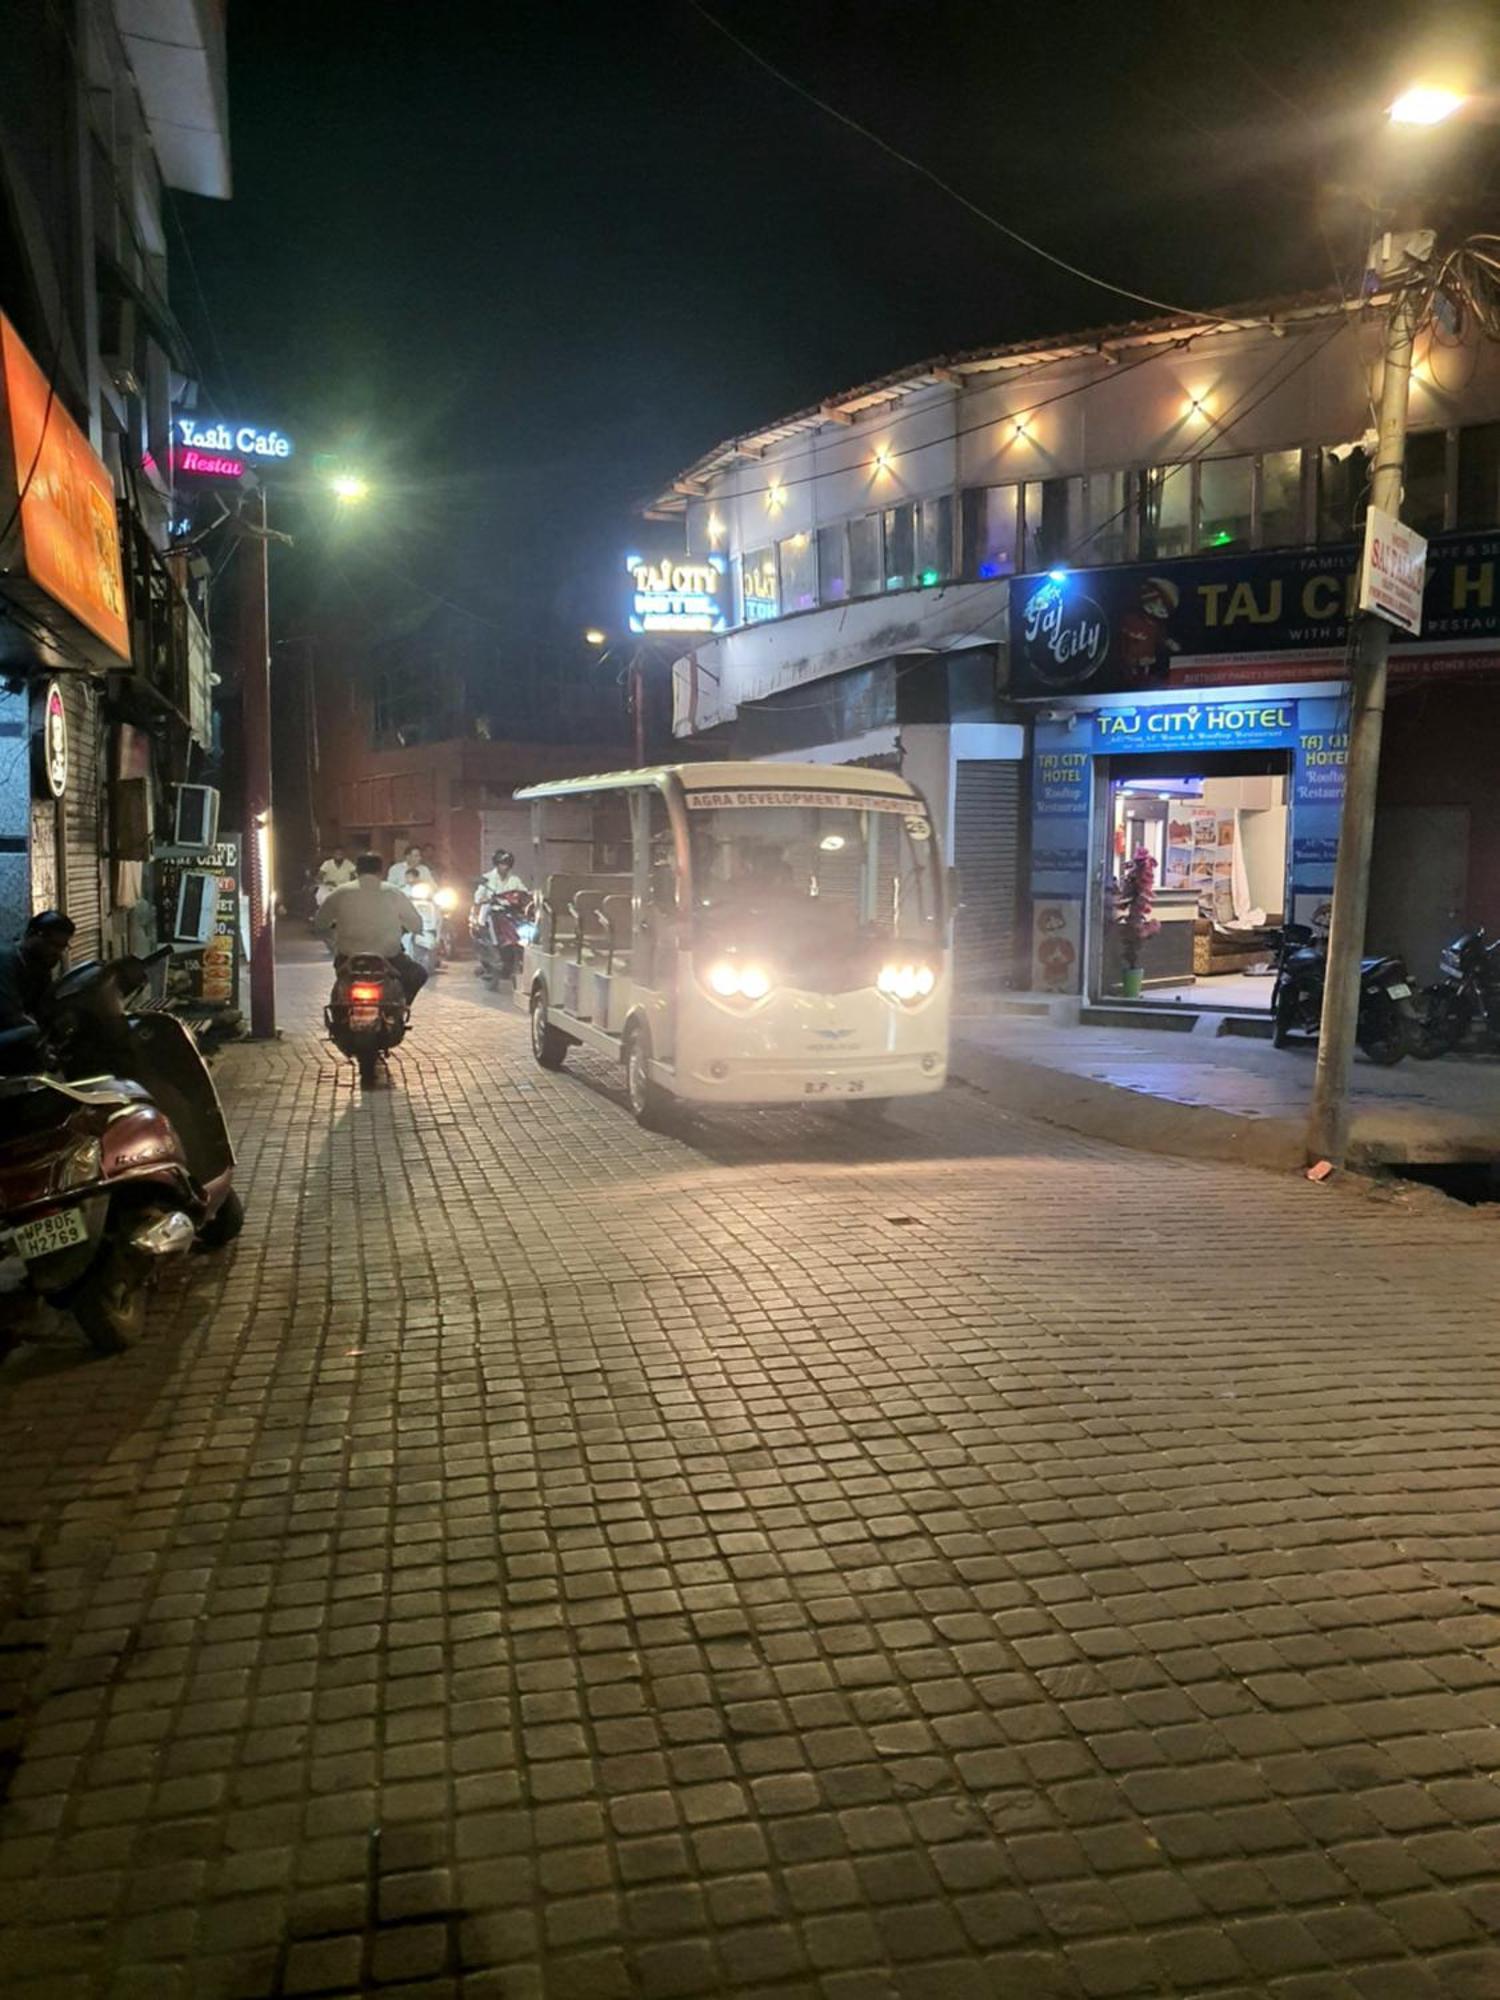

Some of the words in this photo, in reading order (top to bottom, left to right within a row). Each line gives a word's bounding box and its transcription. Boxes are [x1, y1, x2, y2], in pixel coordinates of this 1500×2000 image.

[179, 420, 233, 451] Yash
[236, 428, 290, 457] Cafe
[633, 559, 673, 592] TAJ
[673, 565, 718, 594] CITY
[1198, 580, 1283, 627] TAJ
[1024, 597, 1063, 645] Taj
[1289, 629, 1330, 641] WITH
[1055, 621, 1100, 663] City
[1098, 715, 1140, 734] TAJ
[1148, 706, 1201, 732] CITY
[1208, 709, 1291, 730] HOTEL
[1300, 735, 1324, 751] TAJ
[1040, 755, 1059, 769] TAJ
[1062, 753, 1087, 767] CITY
[1043, 770, 1081, 783] HOTEL
[692, 794, 733, 806] AGRA
[738, 793, 842, 807] DEVELOPMENT
